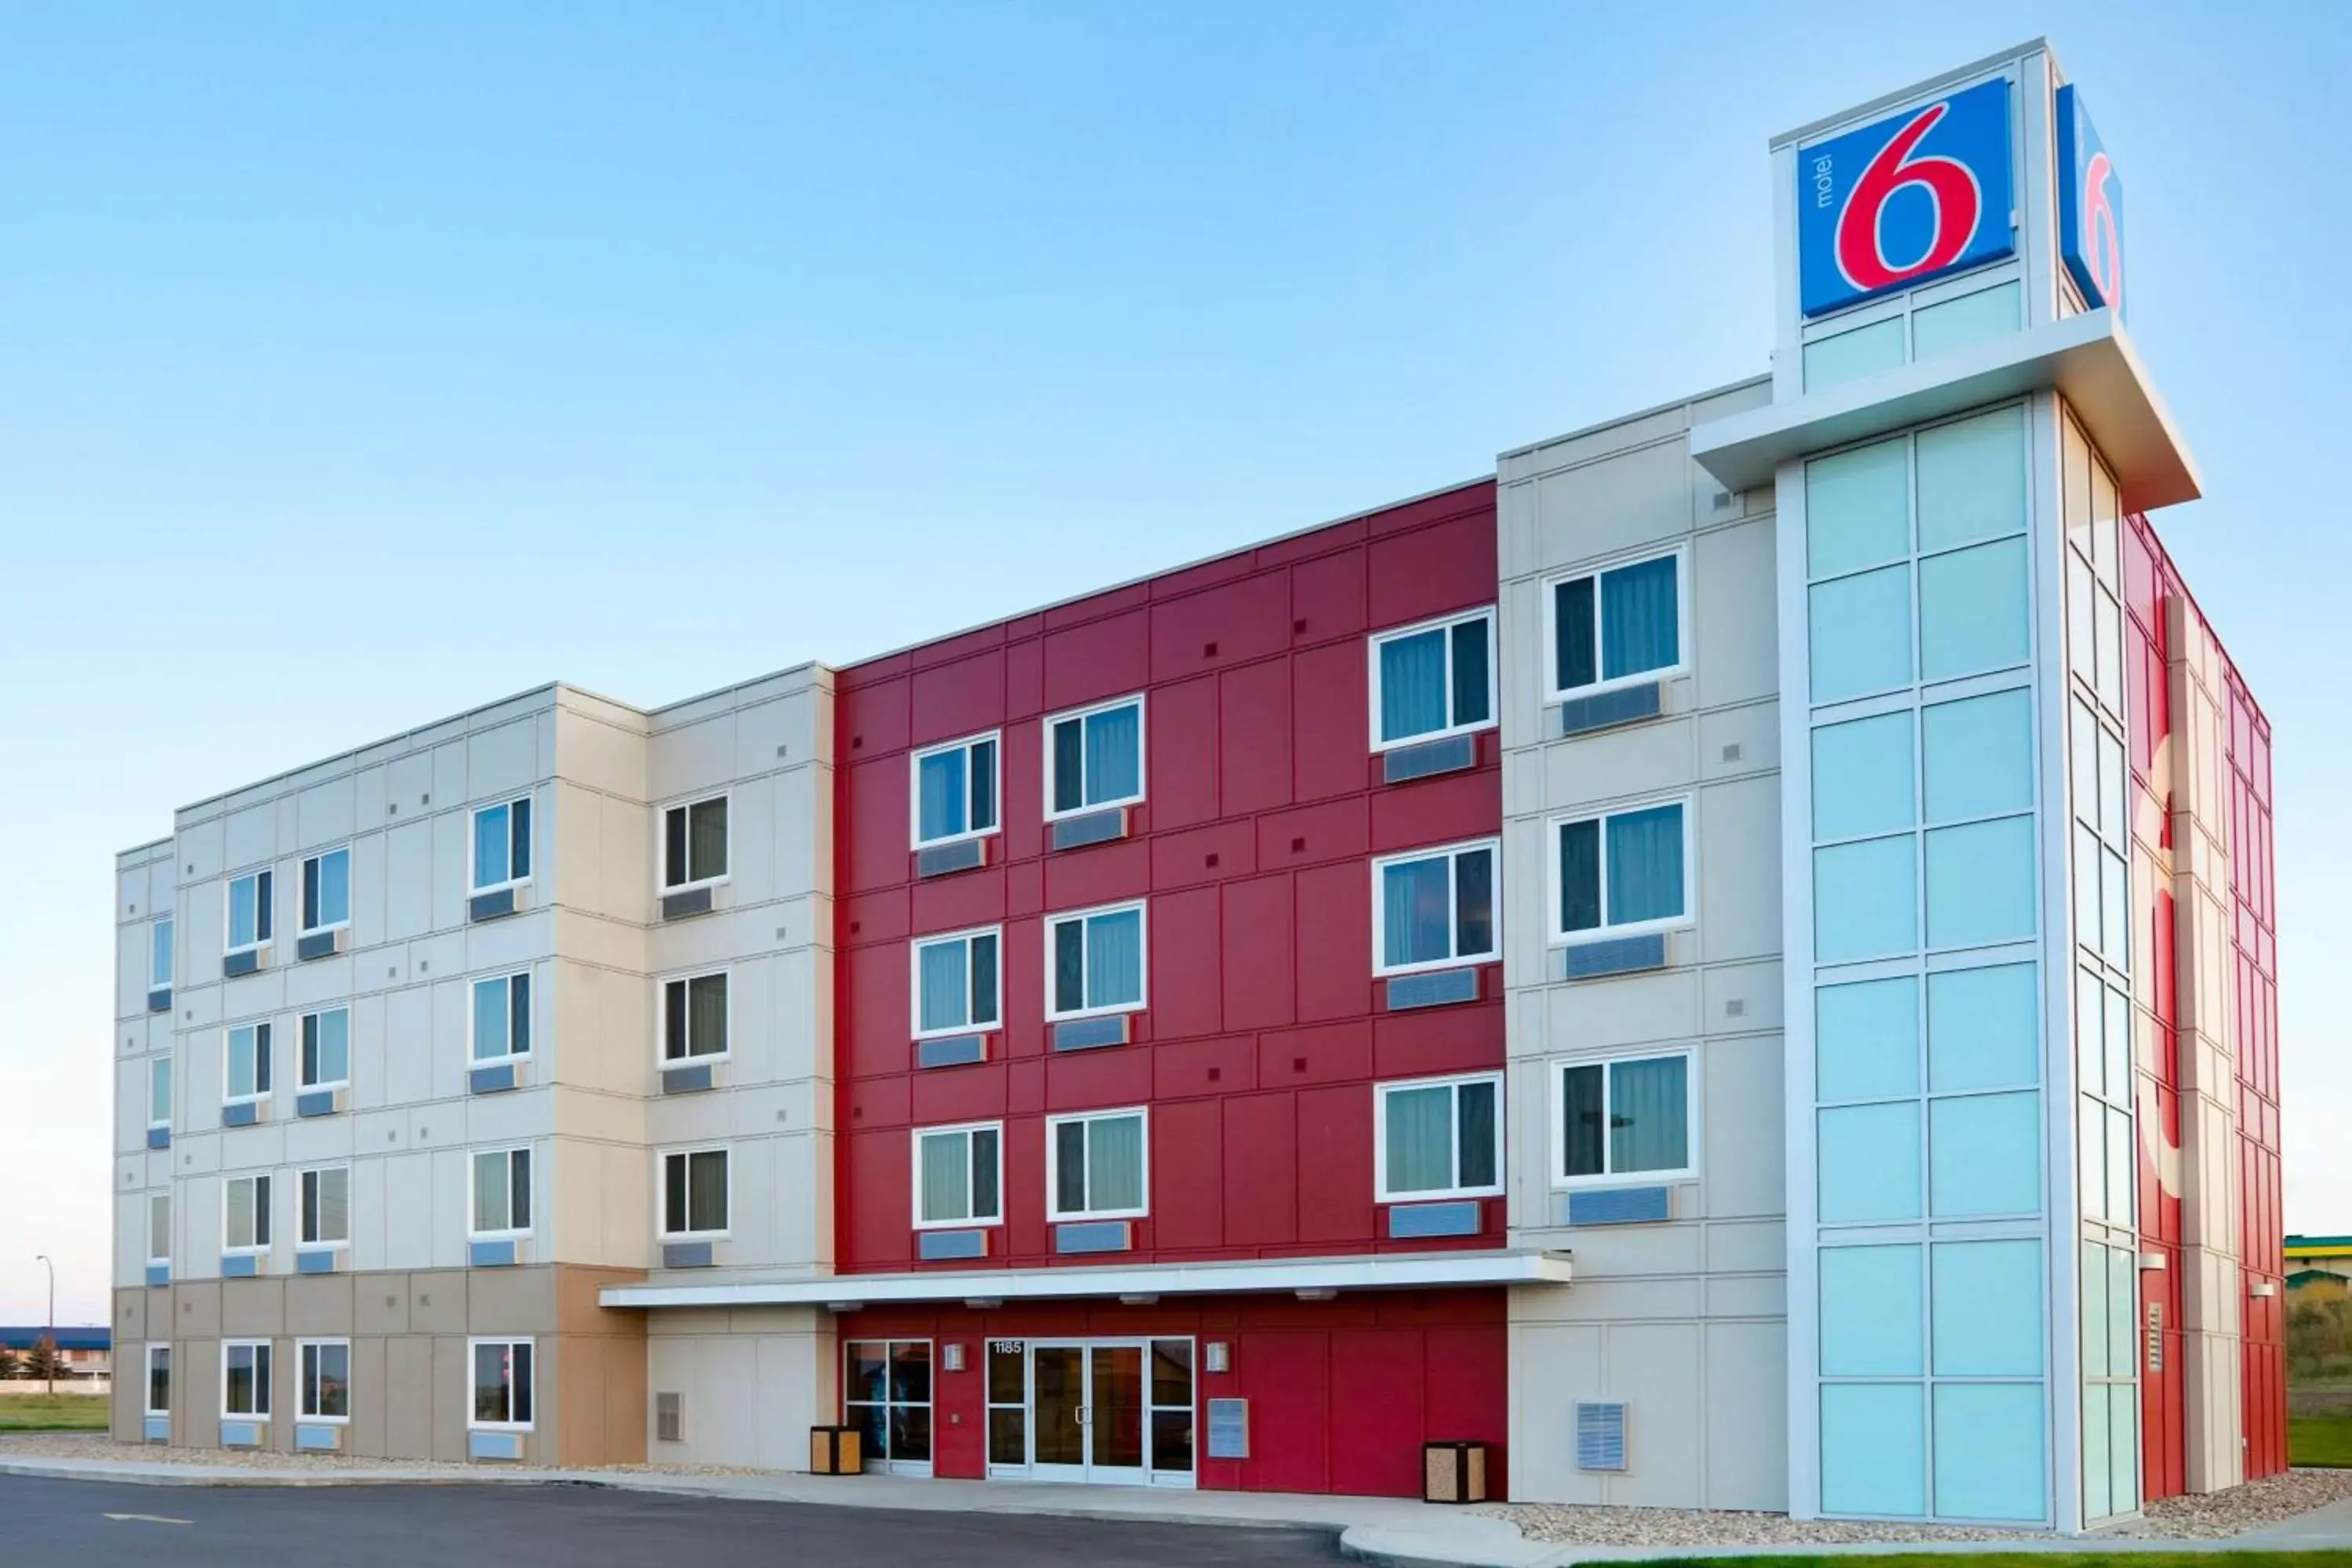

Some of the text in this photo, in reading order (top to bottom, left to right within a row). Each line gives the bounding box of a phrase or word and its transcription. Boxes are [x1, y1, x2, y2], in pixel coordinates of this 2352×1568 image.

[1812, 154, 1832, 208] motel
[1835, 101, 1982, 292] 6
[2085, 151, 2121, 313] 6
[993, 1341, 1021, 1353] 1185
